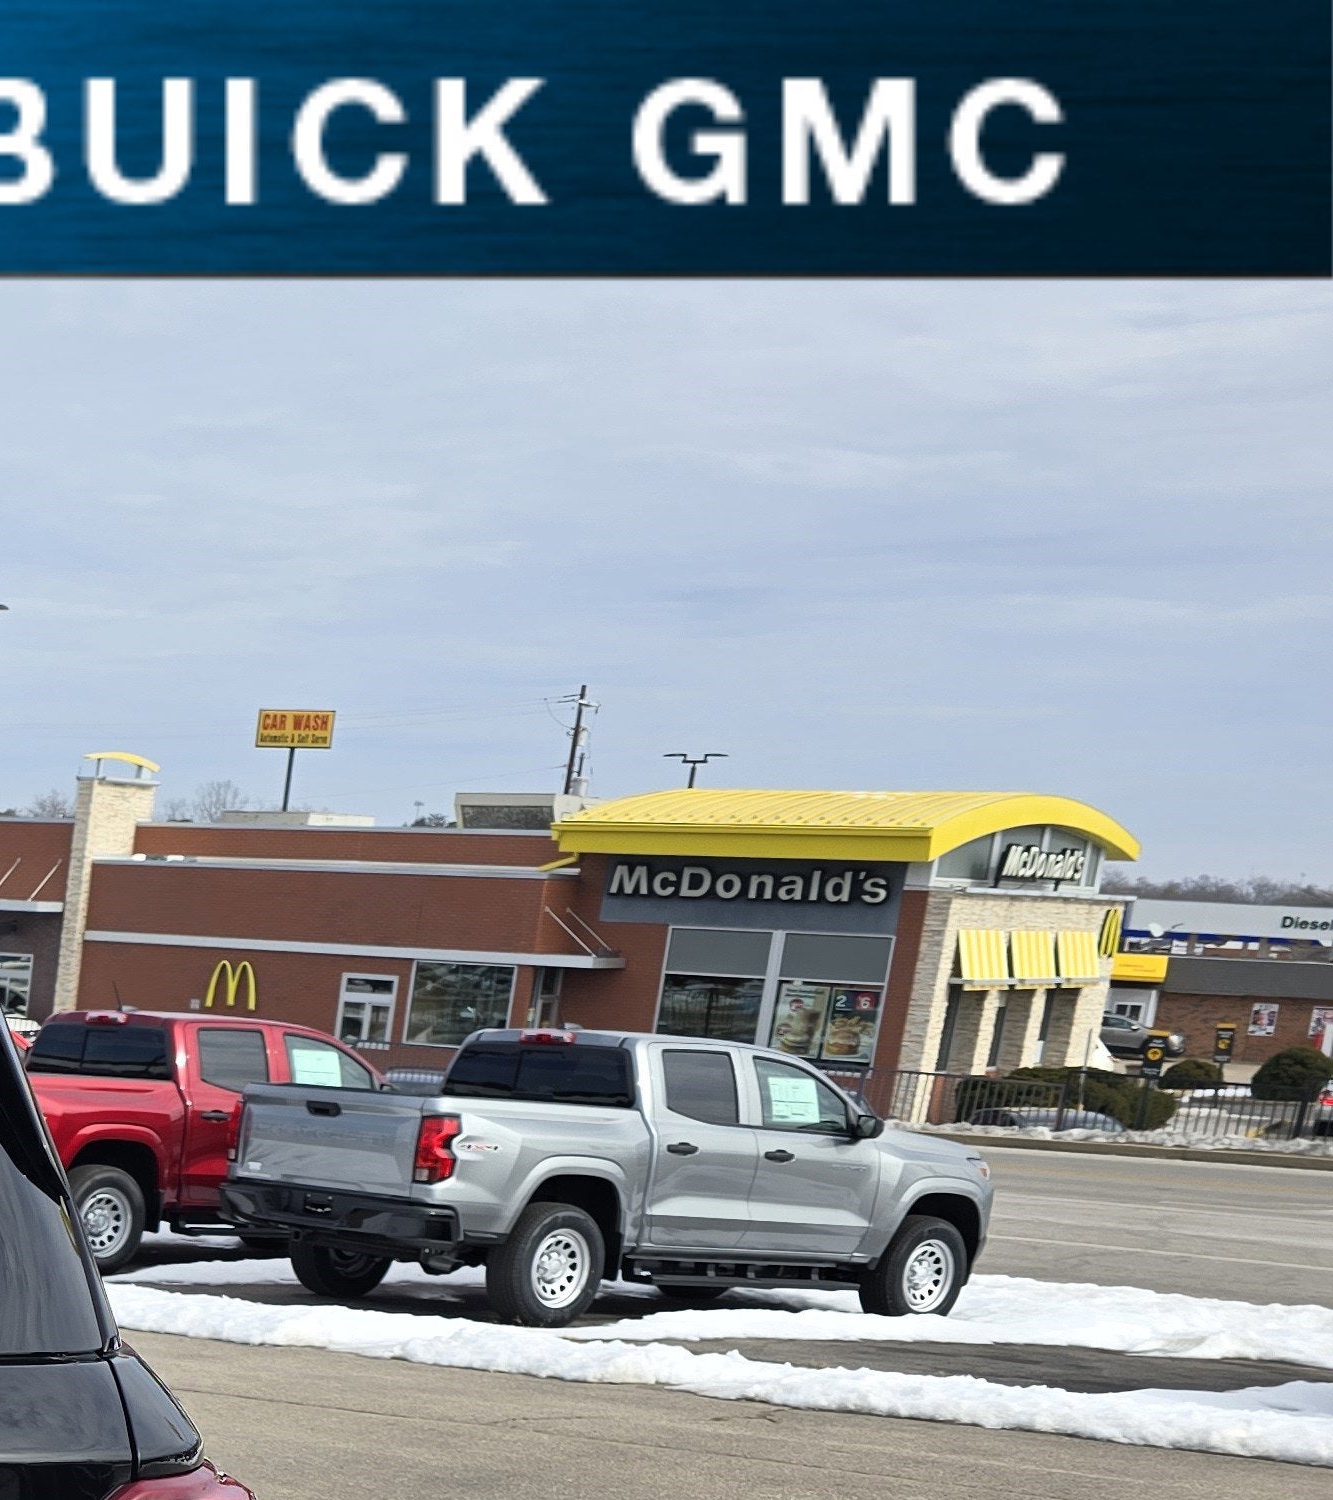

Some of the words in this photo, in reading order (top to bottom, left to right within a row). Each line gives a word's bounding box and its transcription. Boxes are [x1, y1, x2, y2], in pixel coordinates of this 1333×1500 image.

[262, 714, 288, 731] CAR
[293, 714, 330, 731] WASH
[1000, 844, 1085, 880] McDonald's
[609, 864, 888, 904] McDonald's
